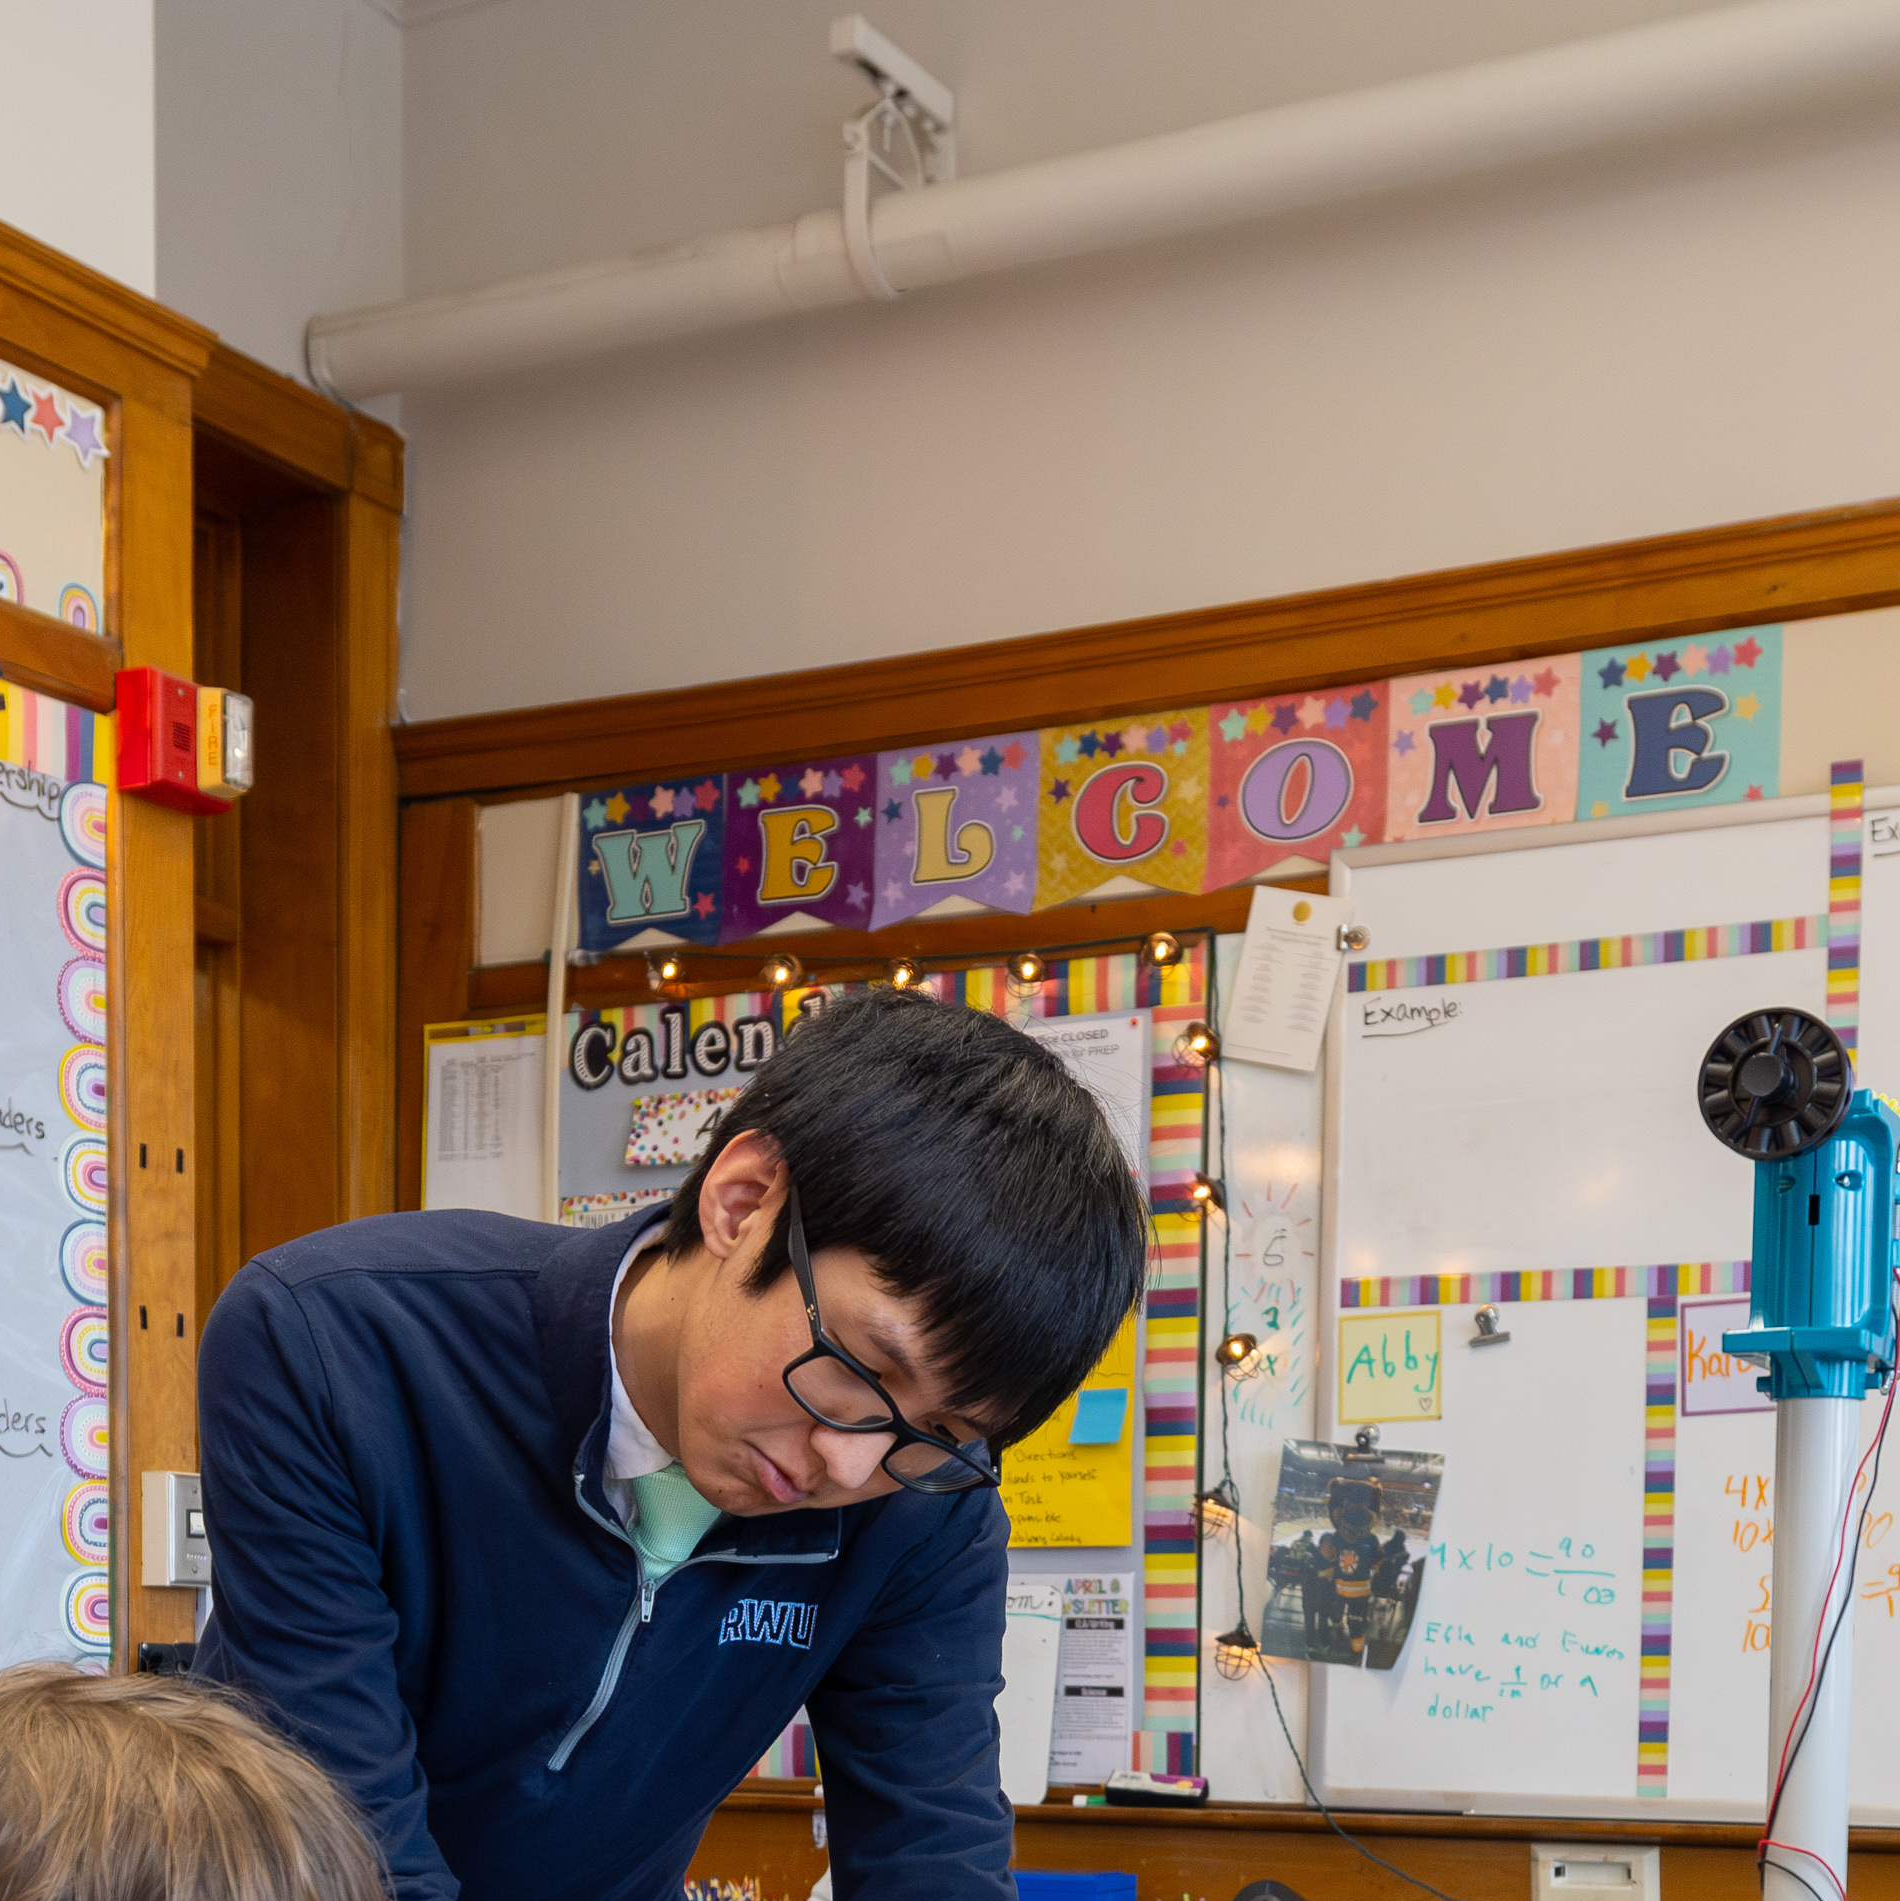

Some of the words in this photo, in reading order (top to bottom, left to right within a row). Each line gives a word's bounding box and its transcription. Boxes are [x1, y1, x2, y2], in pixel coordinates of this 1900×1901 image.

[208, 704, 218, 767] FIRE
[592, 684, 1731, 924] WELCOME
[1363, 997, 1464, 1030] Example:
[1061, 1028, 1109, 1043] CLOSED
[1346, 1339, 1440, 1394] Abby
[1065, 1578, 1107, 1595] APRIL
[718, 1597, 819, 1651] RWU
[1427, 1693, 1495, 1723] dollar
